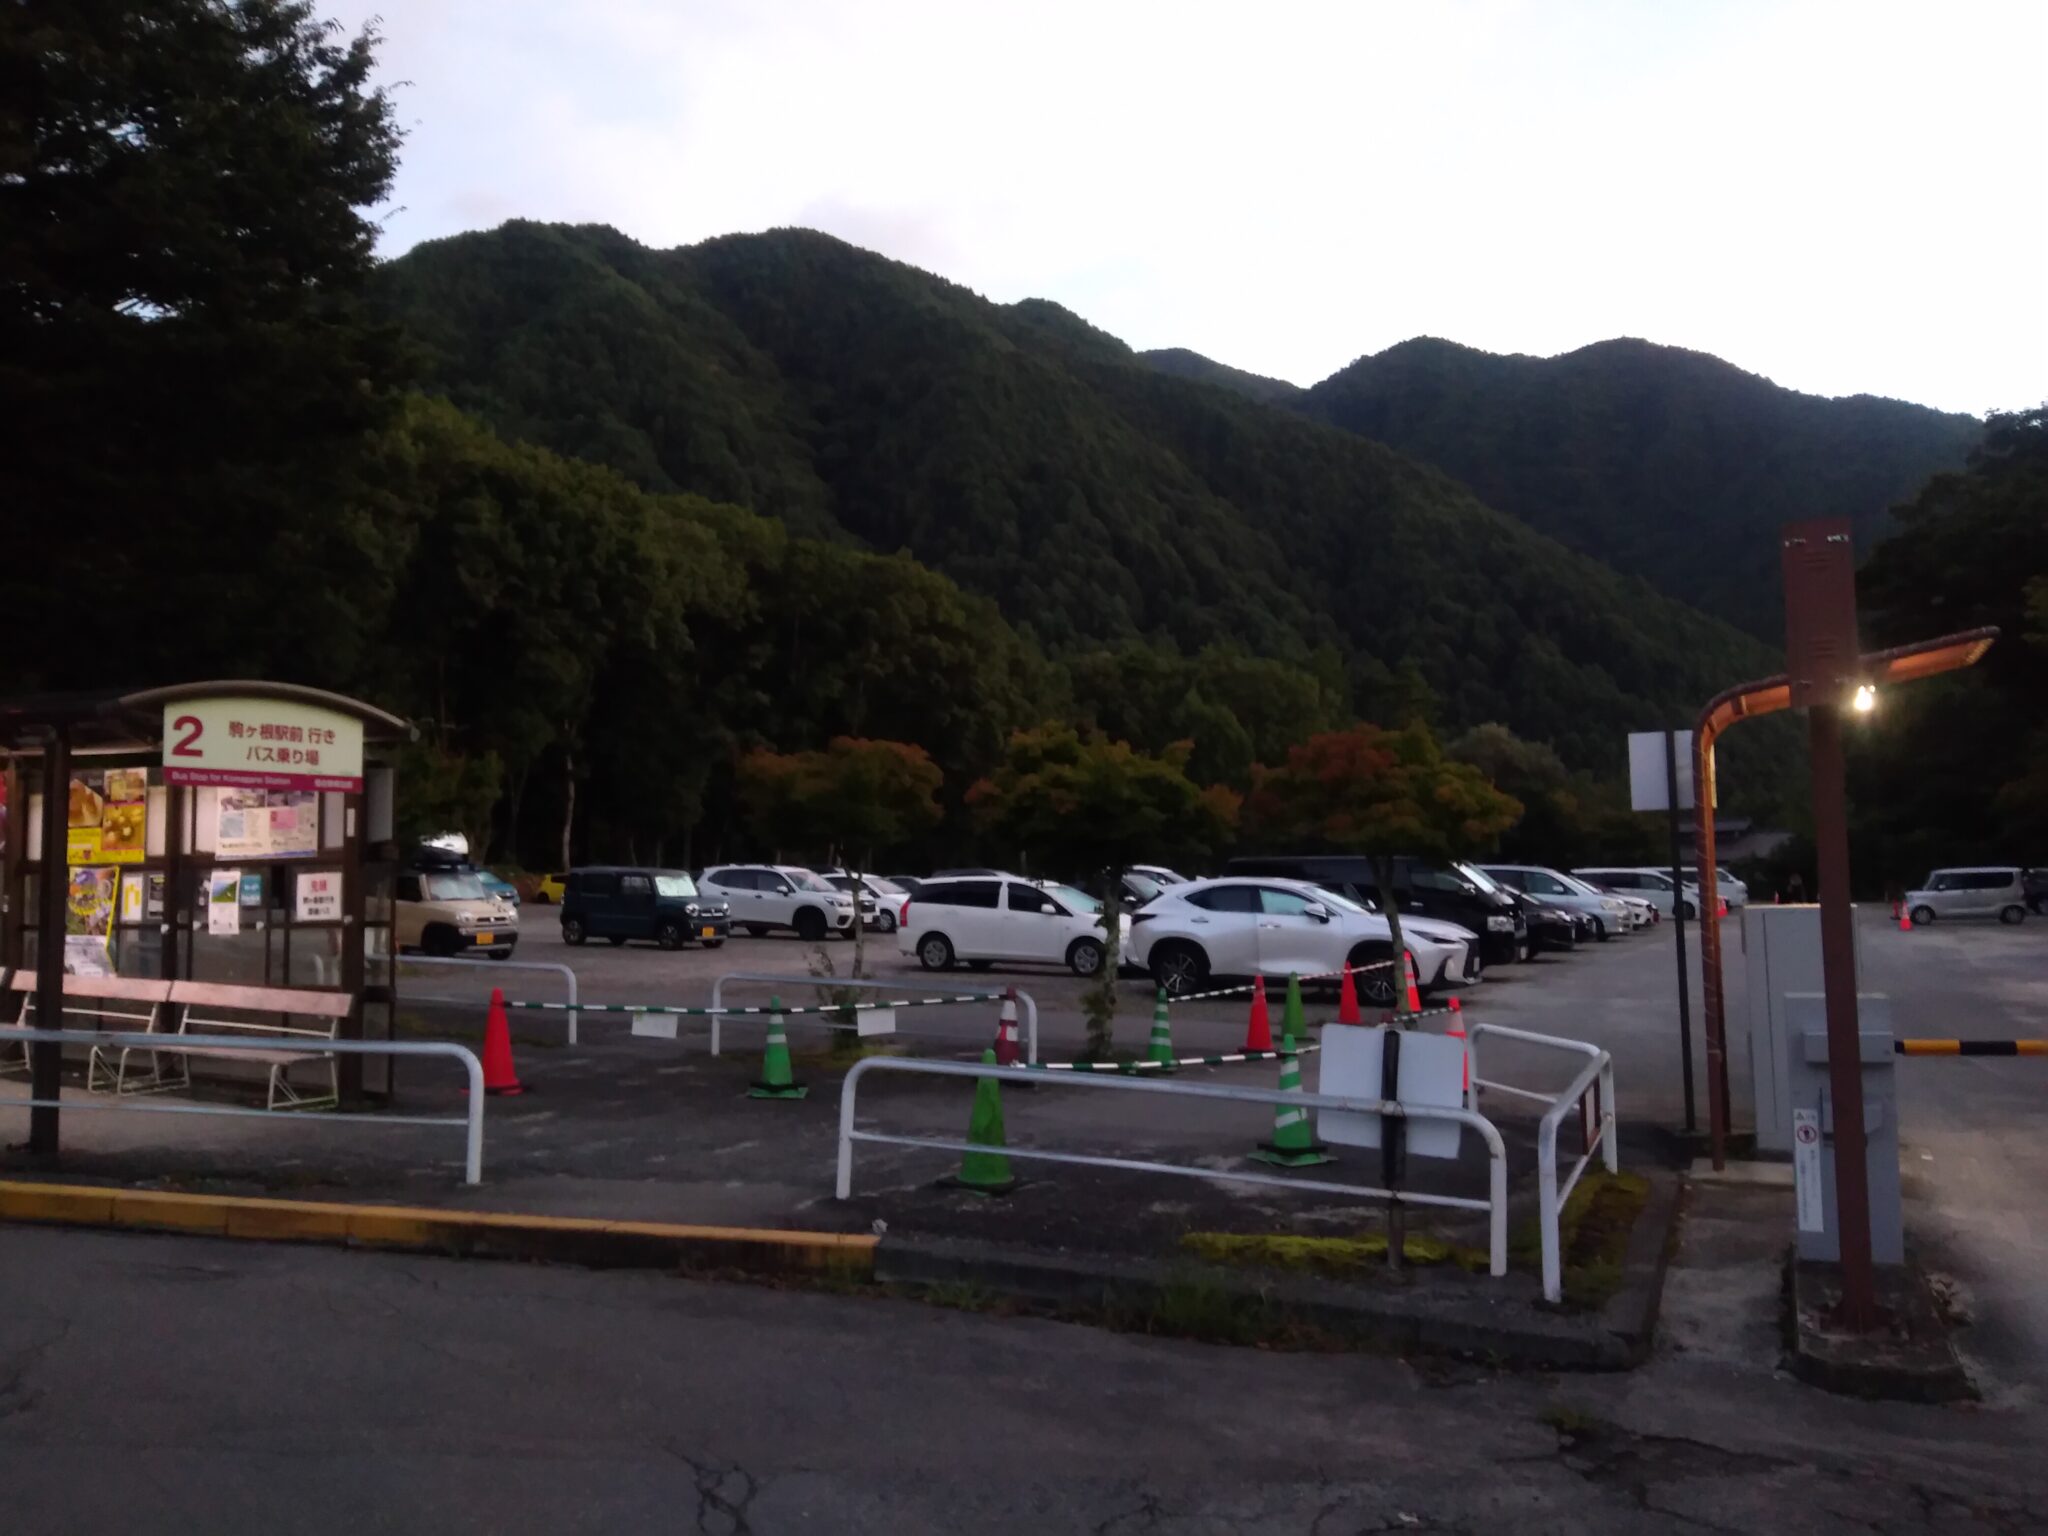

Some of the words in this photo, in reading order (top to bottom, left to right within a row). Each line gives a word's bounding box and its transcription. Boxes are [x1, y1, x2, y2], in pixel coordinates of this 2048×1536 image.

[171, 715, 204, 757] 2
[246, 746, 320, 766] バス乗り場
